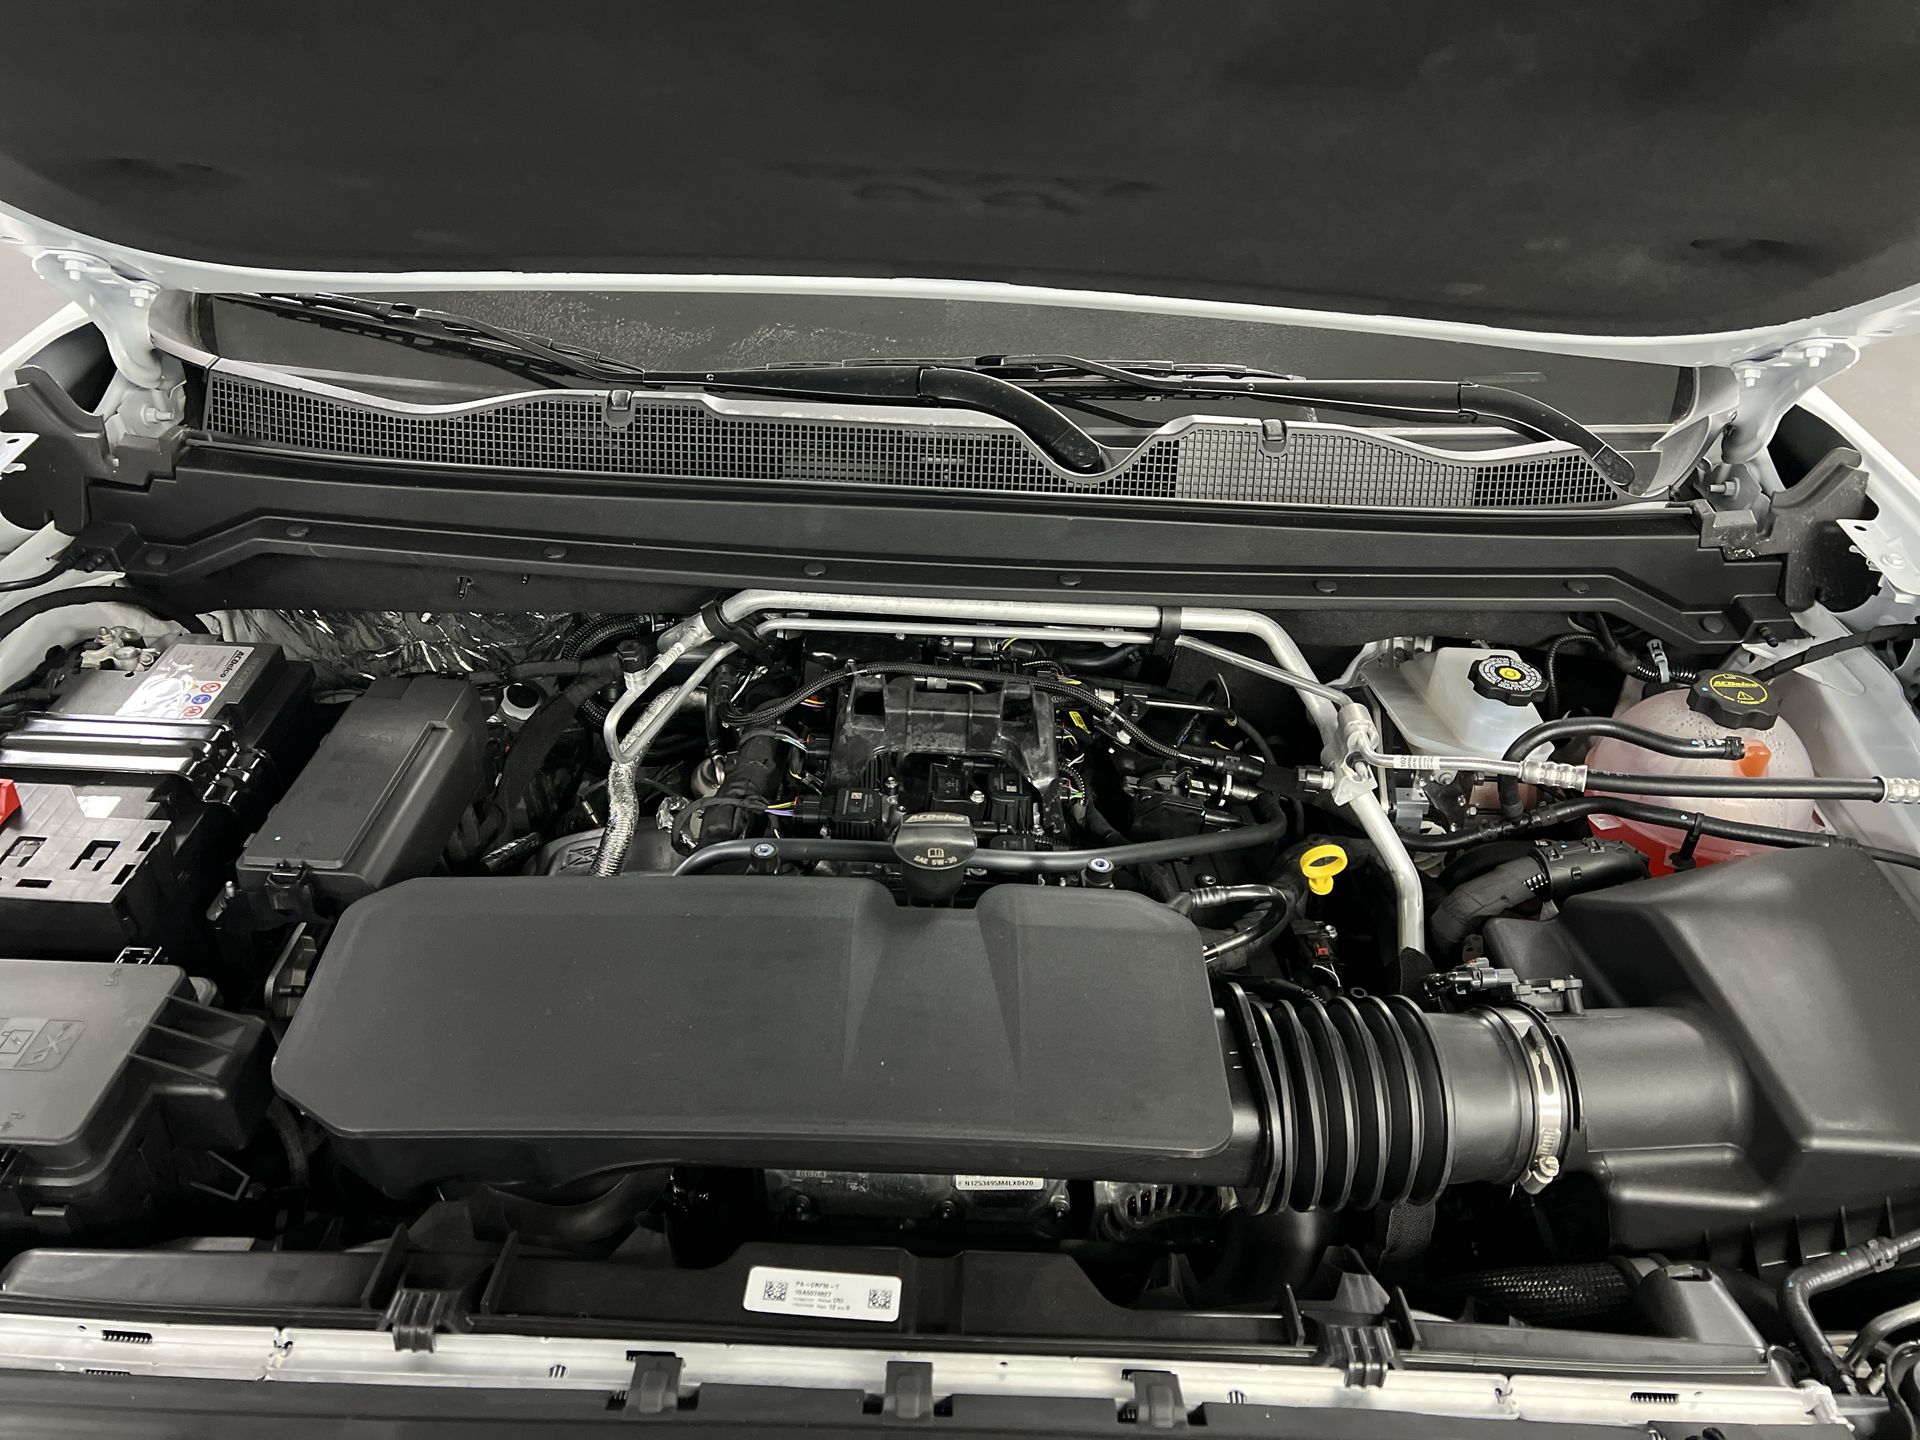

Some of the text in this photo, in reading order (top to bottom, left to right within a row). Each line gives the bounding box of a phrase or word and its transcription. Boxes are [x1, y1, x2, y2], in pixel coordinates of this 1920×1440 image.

[220, 650, 245, 678] ACDelco
[1713, 680, 1760, 688] ACDelco
[905, 814, 966, 824] ACDelco
[913, 855, 929, 865] SAE
